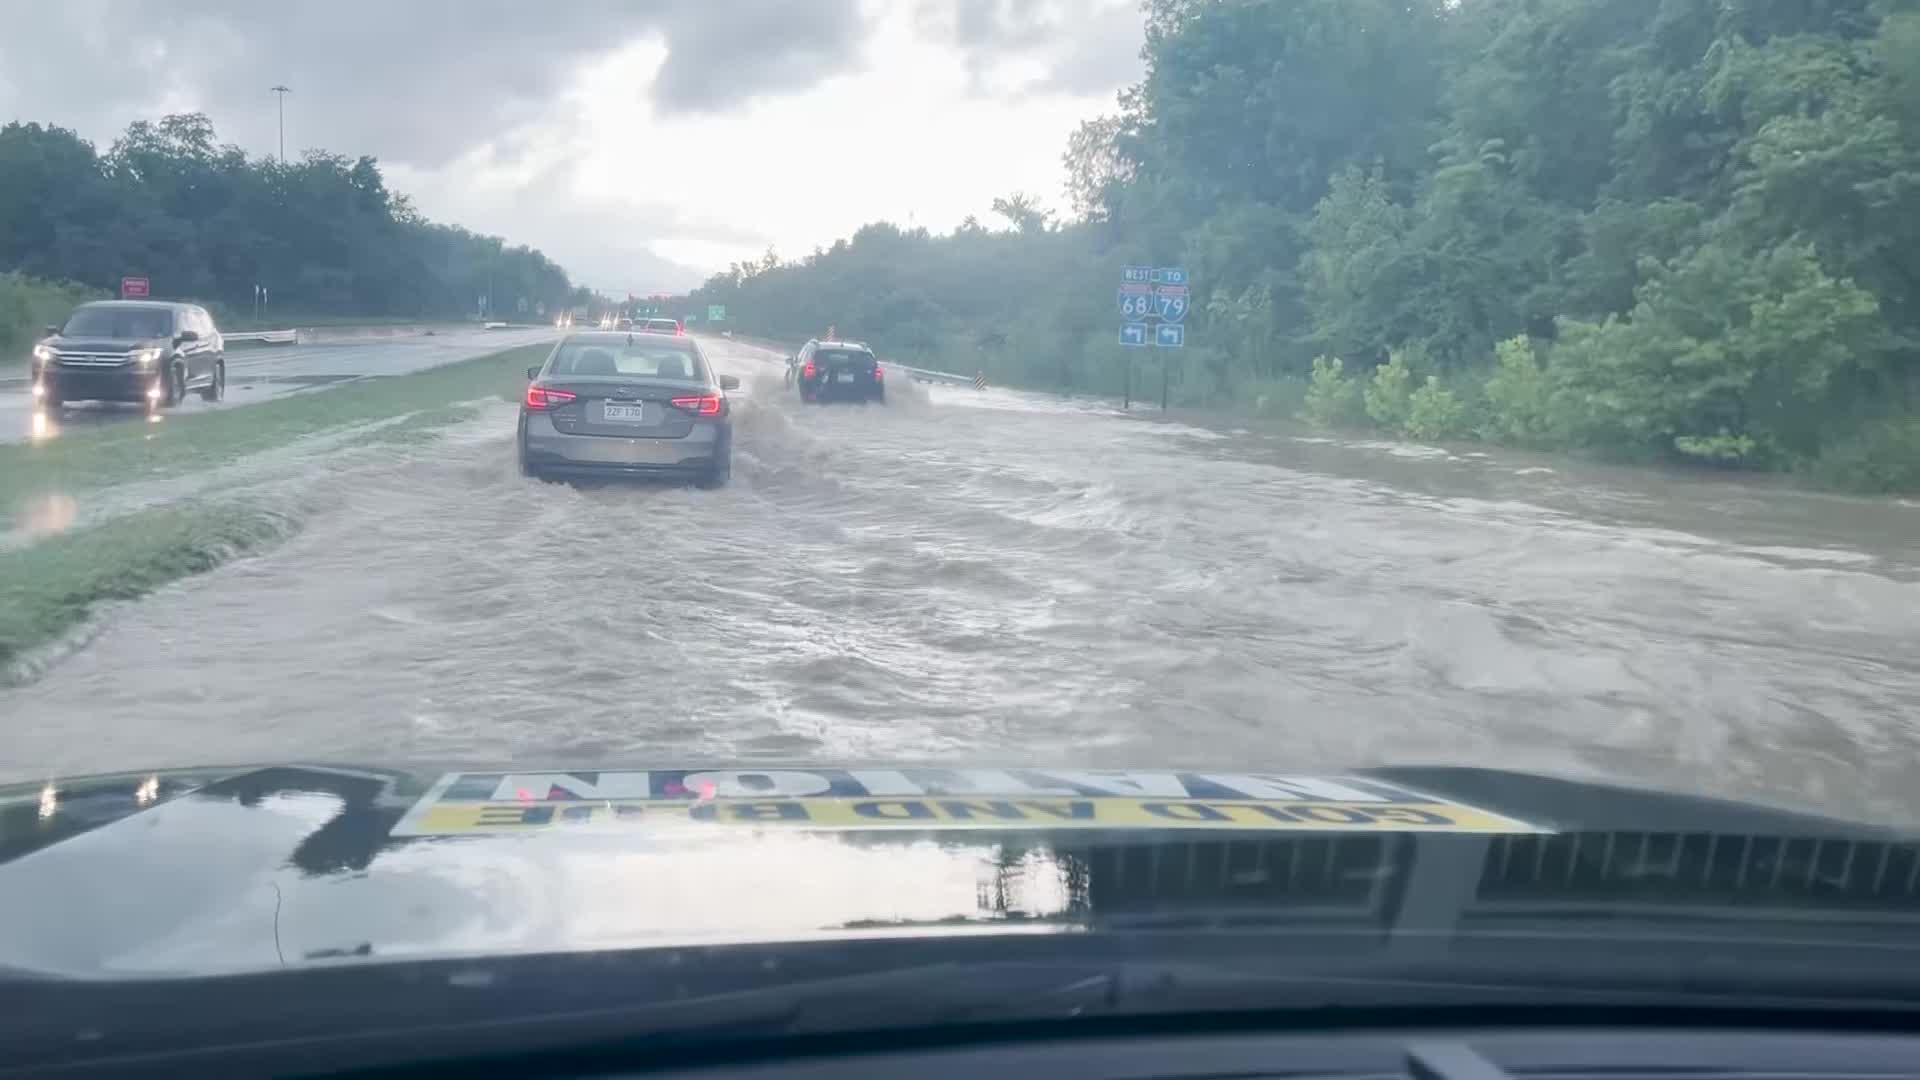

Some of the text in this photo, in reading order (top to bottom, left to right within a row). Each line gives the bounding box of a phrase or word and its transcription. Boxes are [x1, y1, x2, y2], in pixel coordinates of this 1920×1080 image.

[1125, 269, 1149, 281] WEST
[1167, 271, 1181, 281] TO
[1123, 296, 1147, 314] 68
[1160, 298, 1184, 316] 79
[489, 771, 1392, 802] NATION
[852, 801, 1096, 820] AND
[1140, 803, 1456, 825] GOLD
